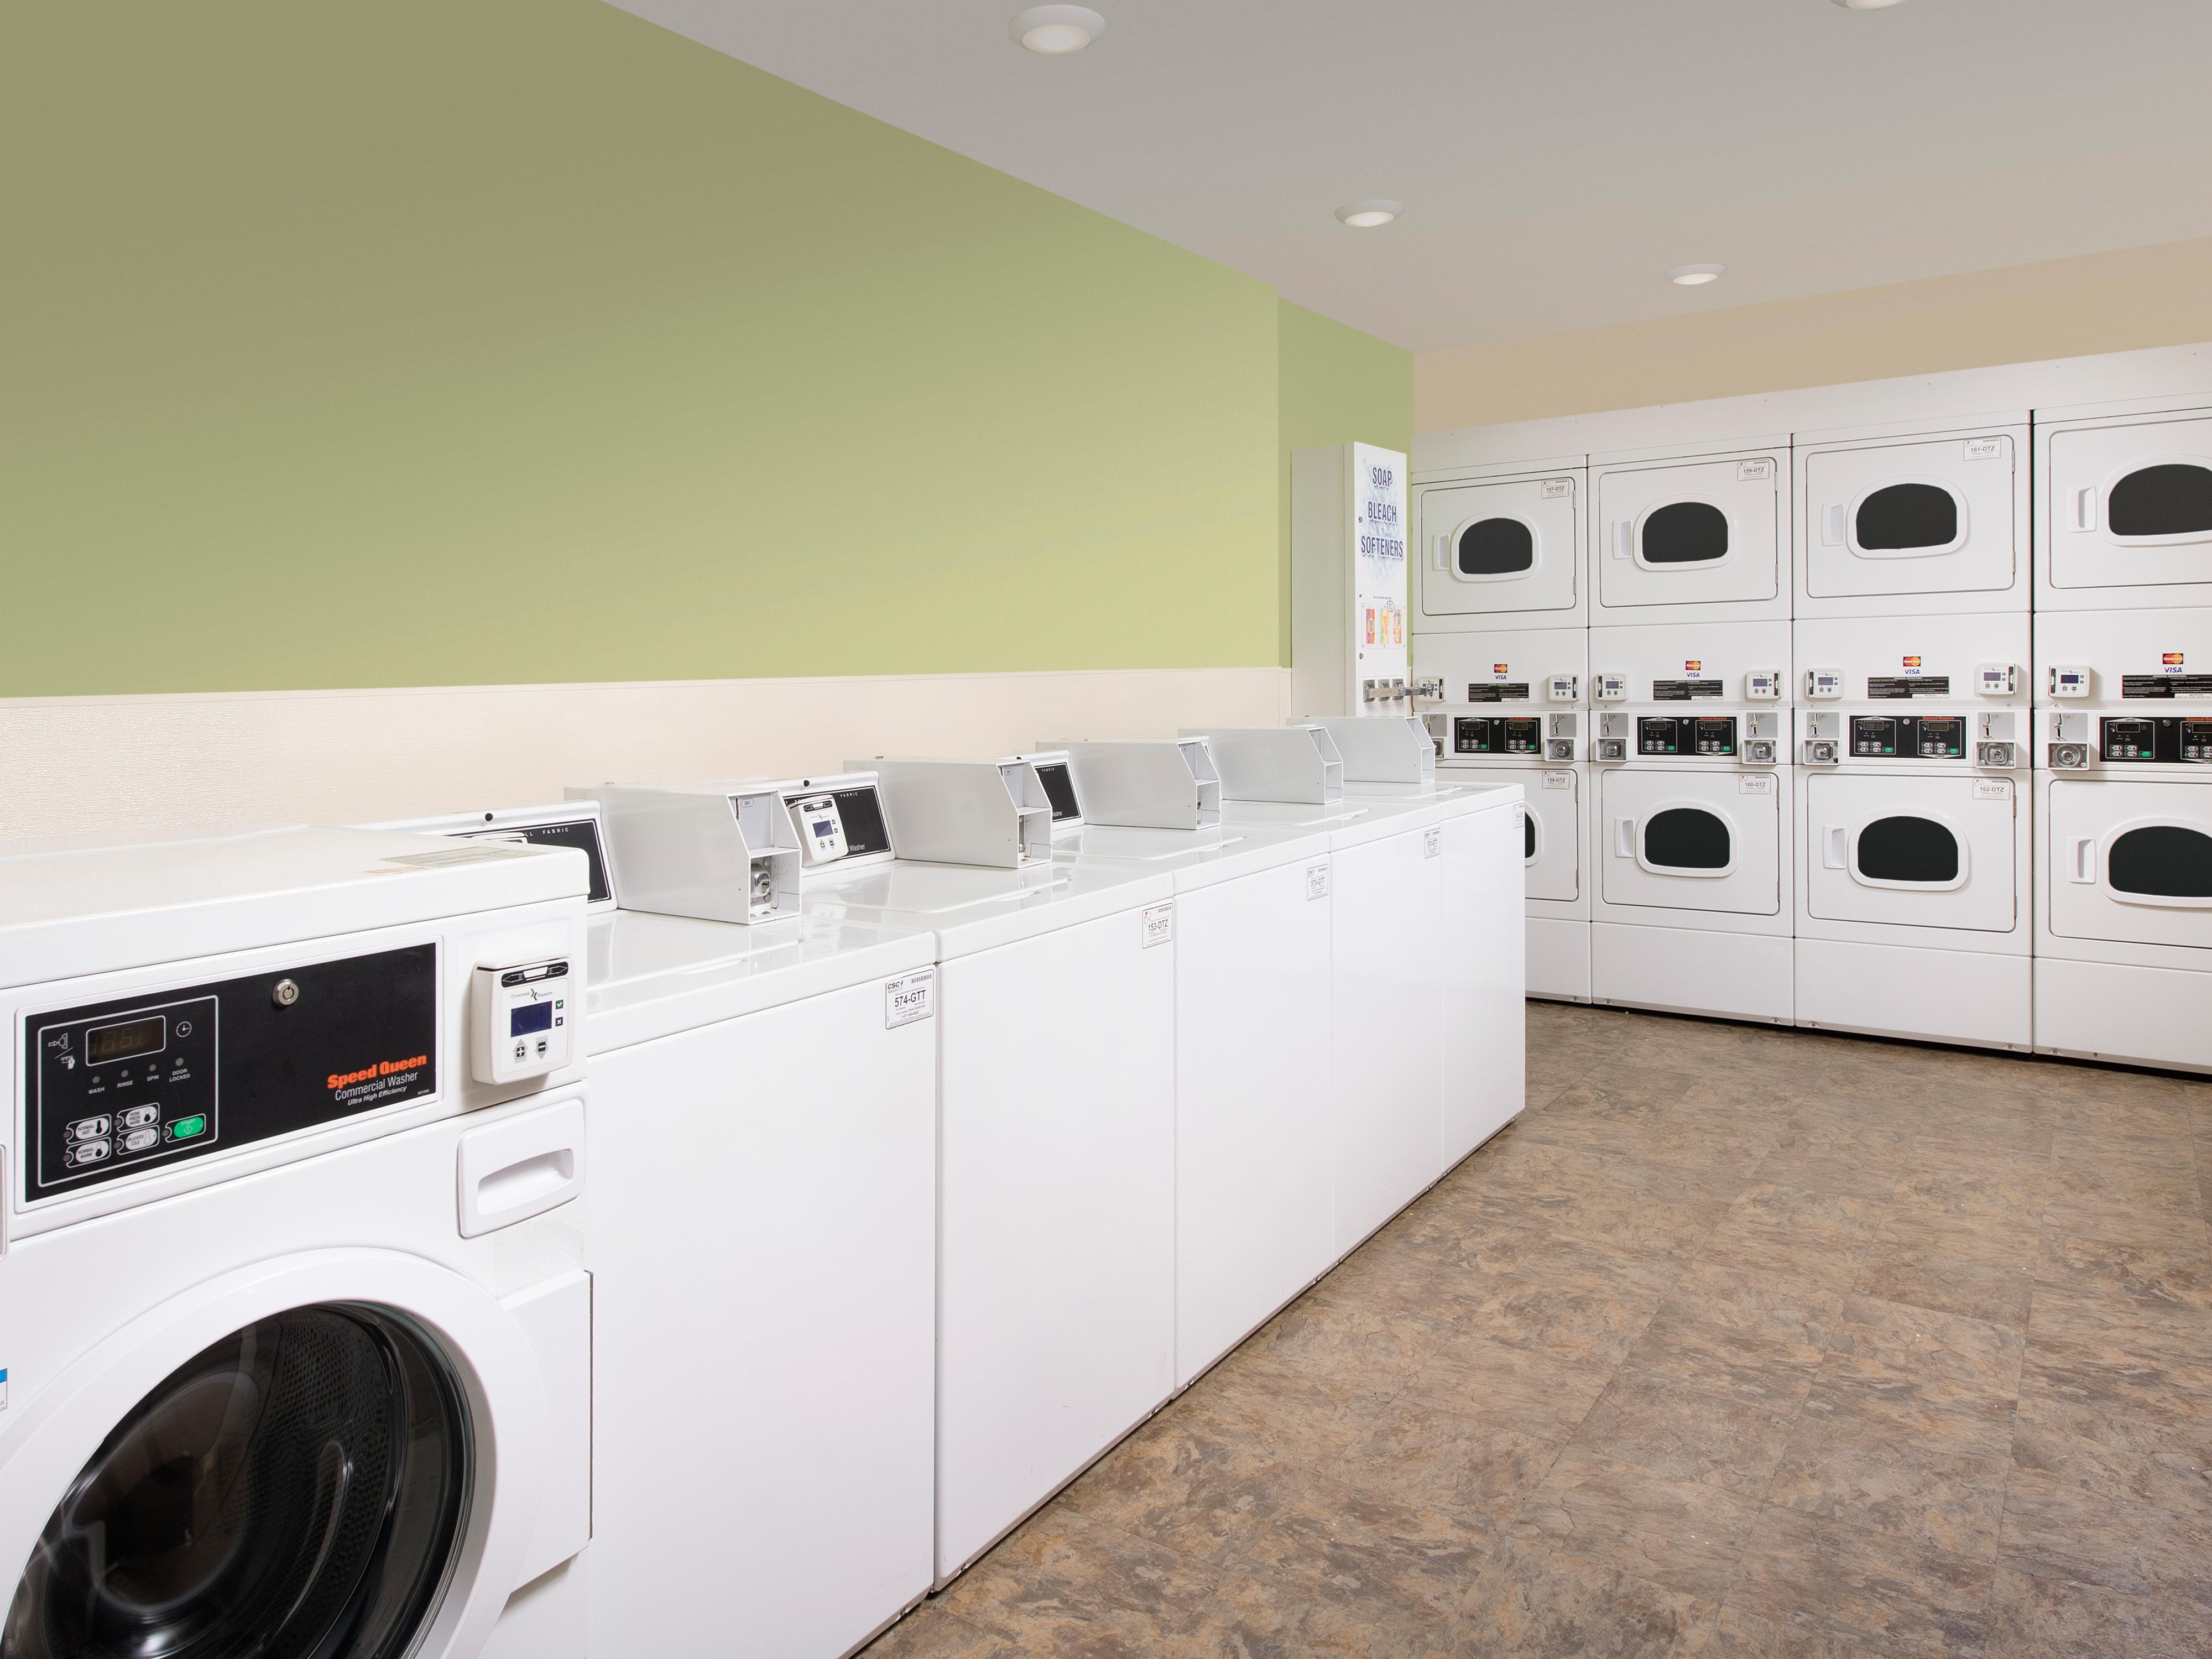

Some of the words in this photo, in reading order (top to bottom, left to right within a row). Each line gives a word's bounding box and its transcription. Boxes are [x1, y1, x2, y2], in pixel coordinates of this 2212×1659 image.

[1373, 467, 1392, 487] SOAP
[1368, 501, 1397, 523] BLEACH
[1361, 535, 1403, 558] SOFTENERS
[849, 843, 865, 852] Washer
[1148, 919, 1168, 932] 153-DTZ
[895, 989, 926, 1008] 574-GTT
[169, 1073, 190, 1082] LOCKED
[172, 1068, 187, 1076] DOOR
[327, 1064, 377, 1089] Speed
[379, 1055, 427, 1075] Queen
[335, 1078, 385, 1101] Commercial
[388, 1072, 419, 1087] Washer
[347, 1097, 362, 1106] Ultra
[363, 1093, 377, 1102] High
[378, 1086, 407, 1098] Efficiency
[127, 1134, 144, 1142] DELICATES
